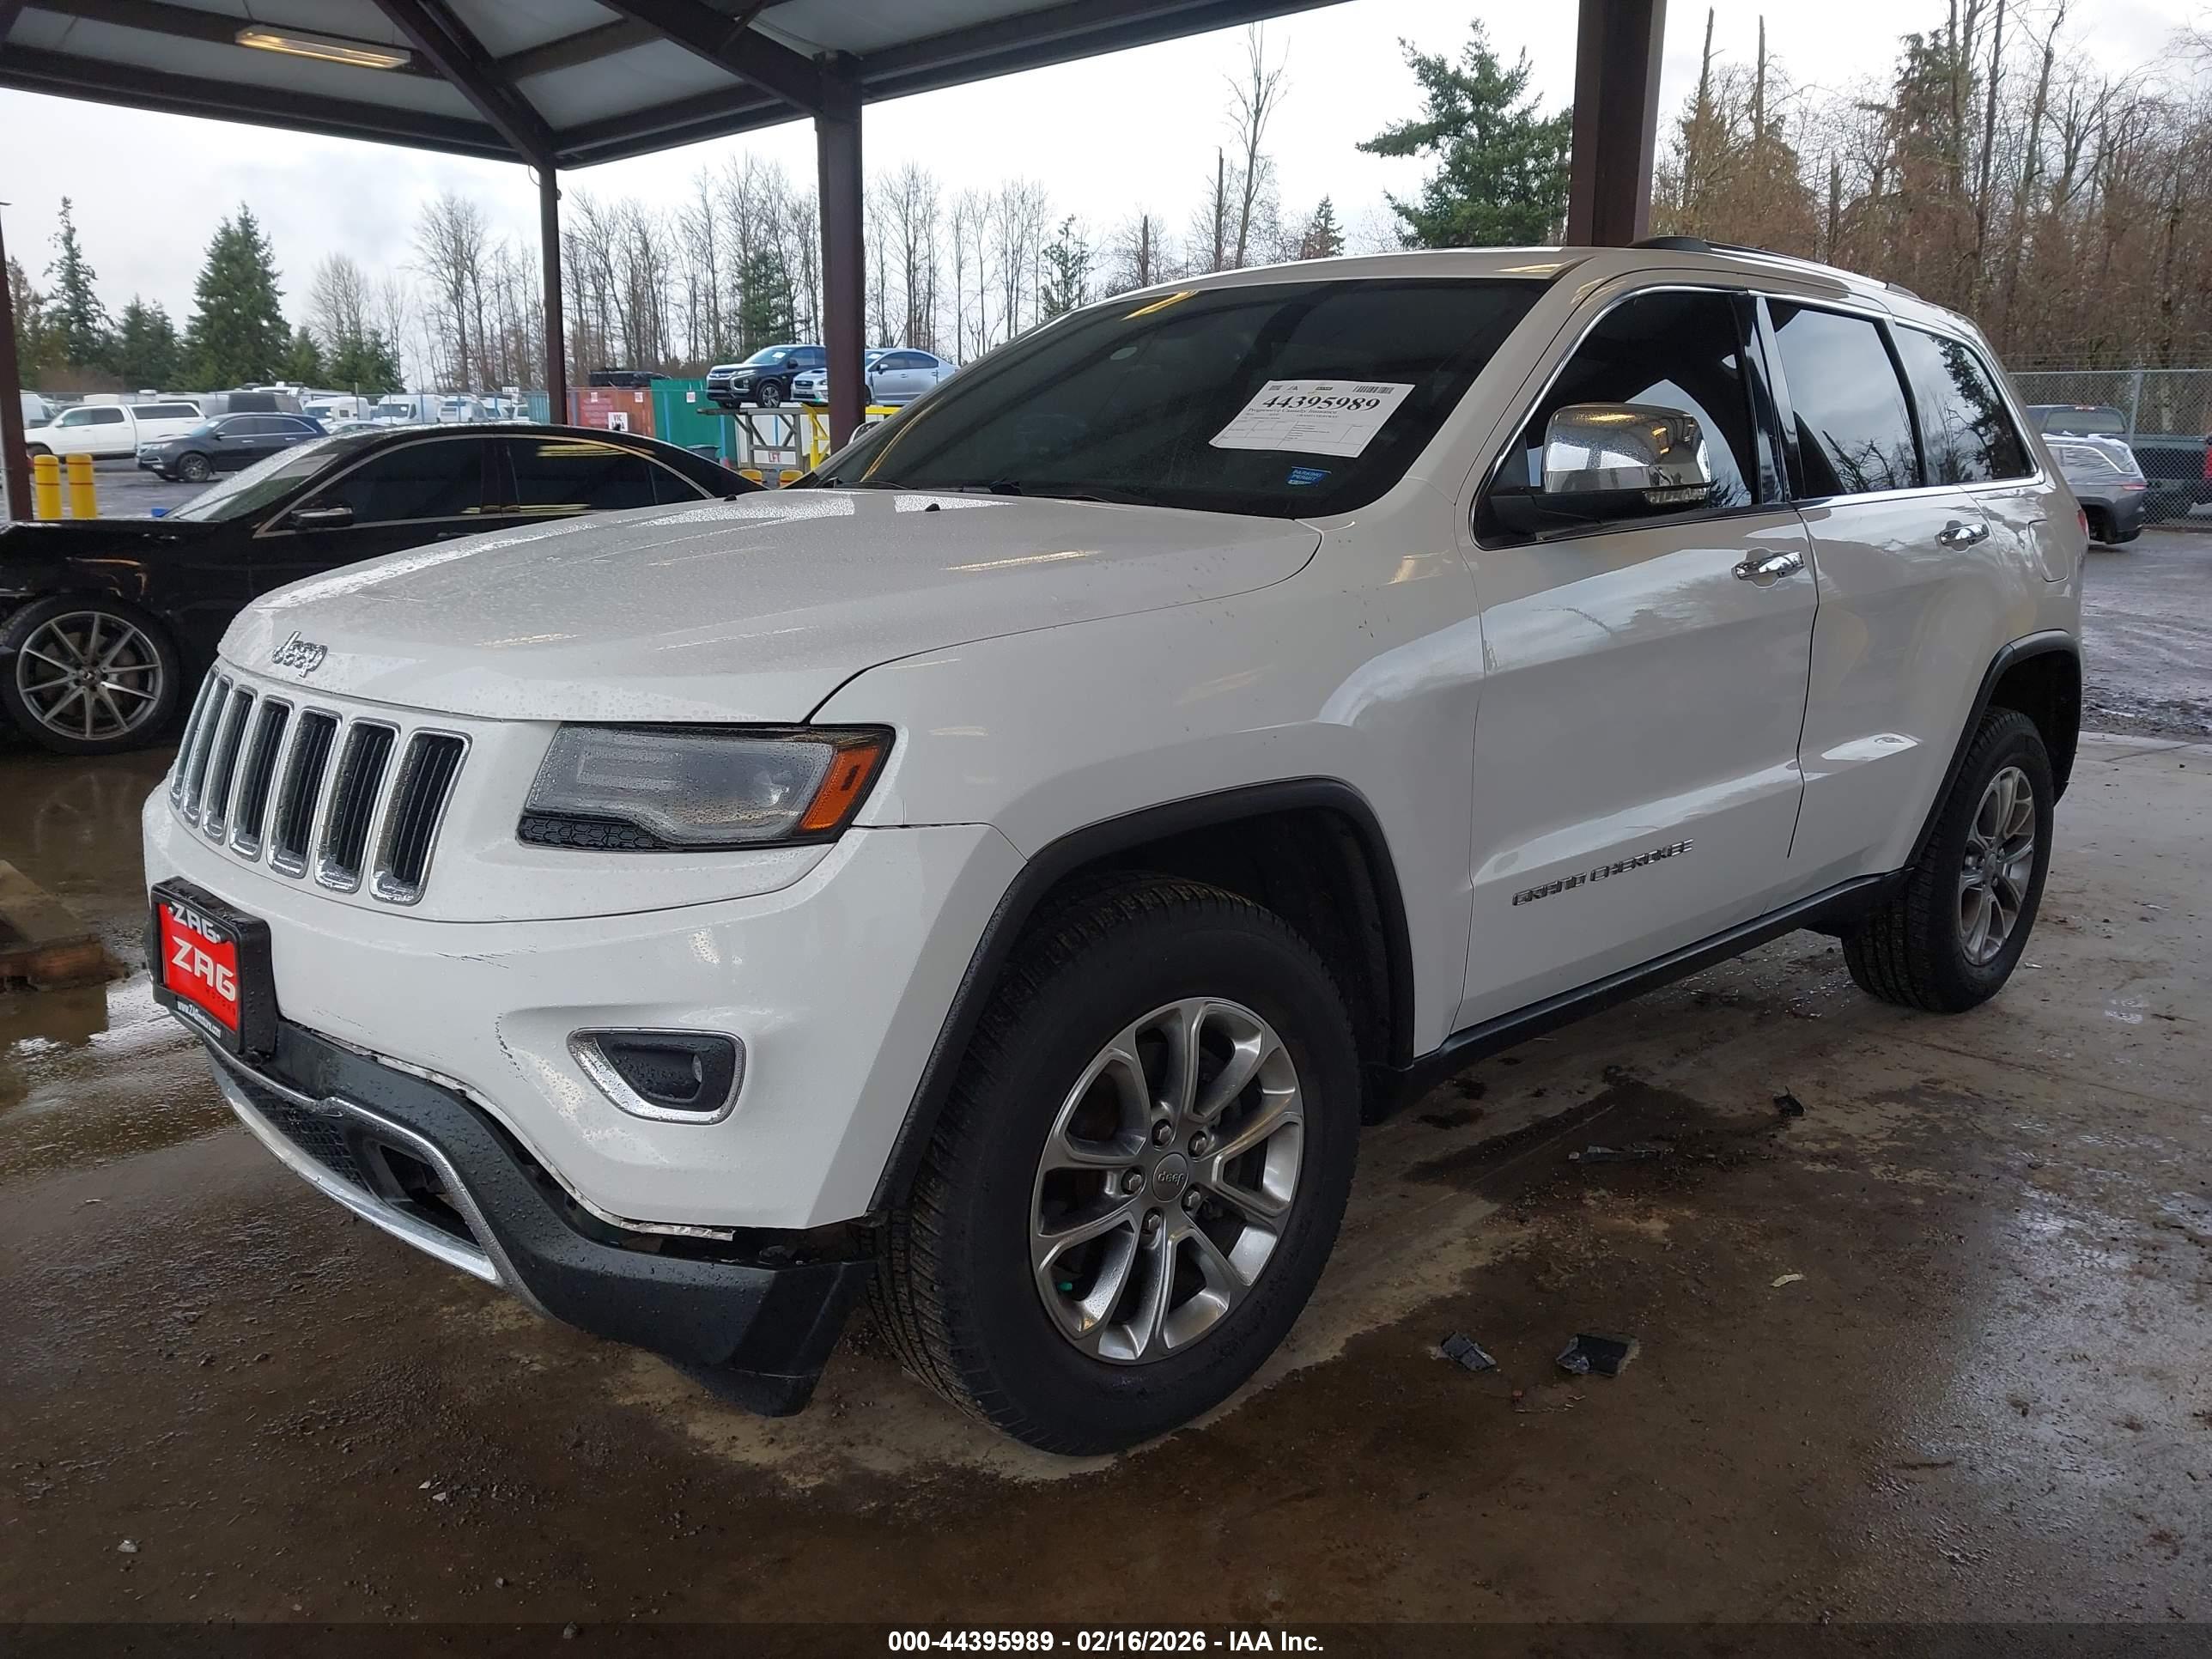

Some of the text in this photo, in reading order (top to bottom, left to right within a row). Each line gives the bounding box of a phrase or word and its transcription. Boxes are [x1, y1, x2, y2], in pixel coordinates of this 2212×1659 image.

[1262, 396, 1381, 411] 44395989
[271, 631, 328, 678] Jeep
[1512, 838, 1694, 906] GRAND CHEROKEE
[171, 902, 219, 944] ZAG
[172, 935, 236, 1002] ZAG
